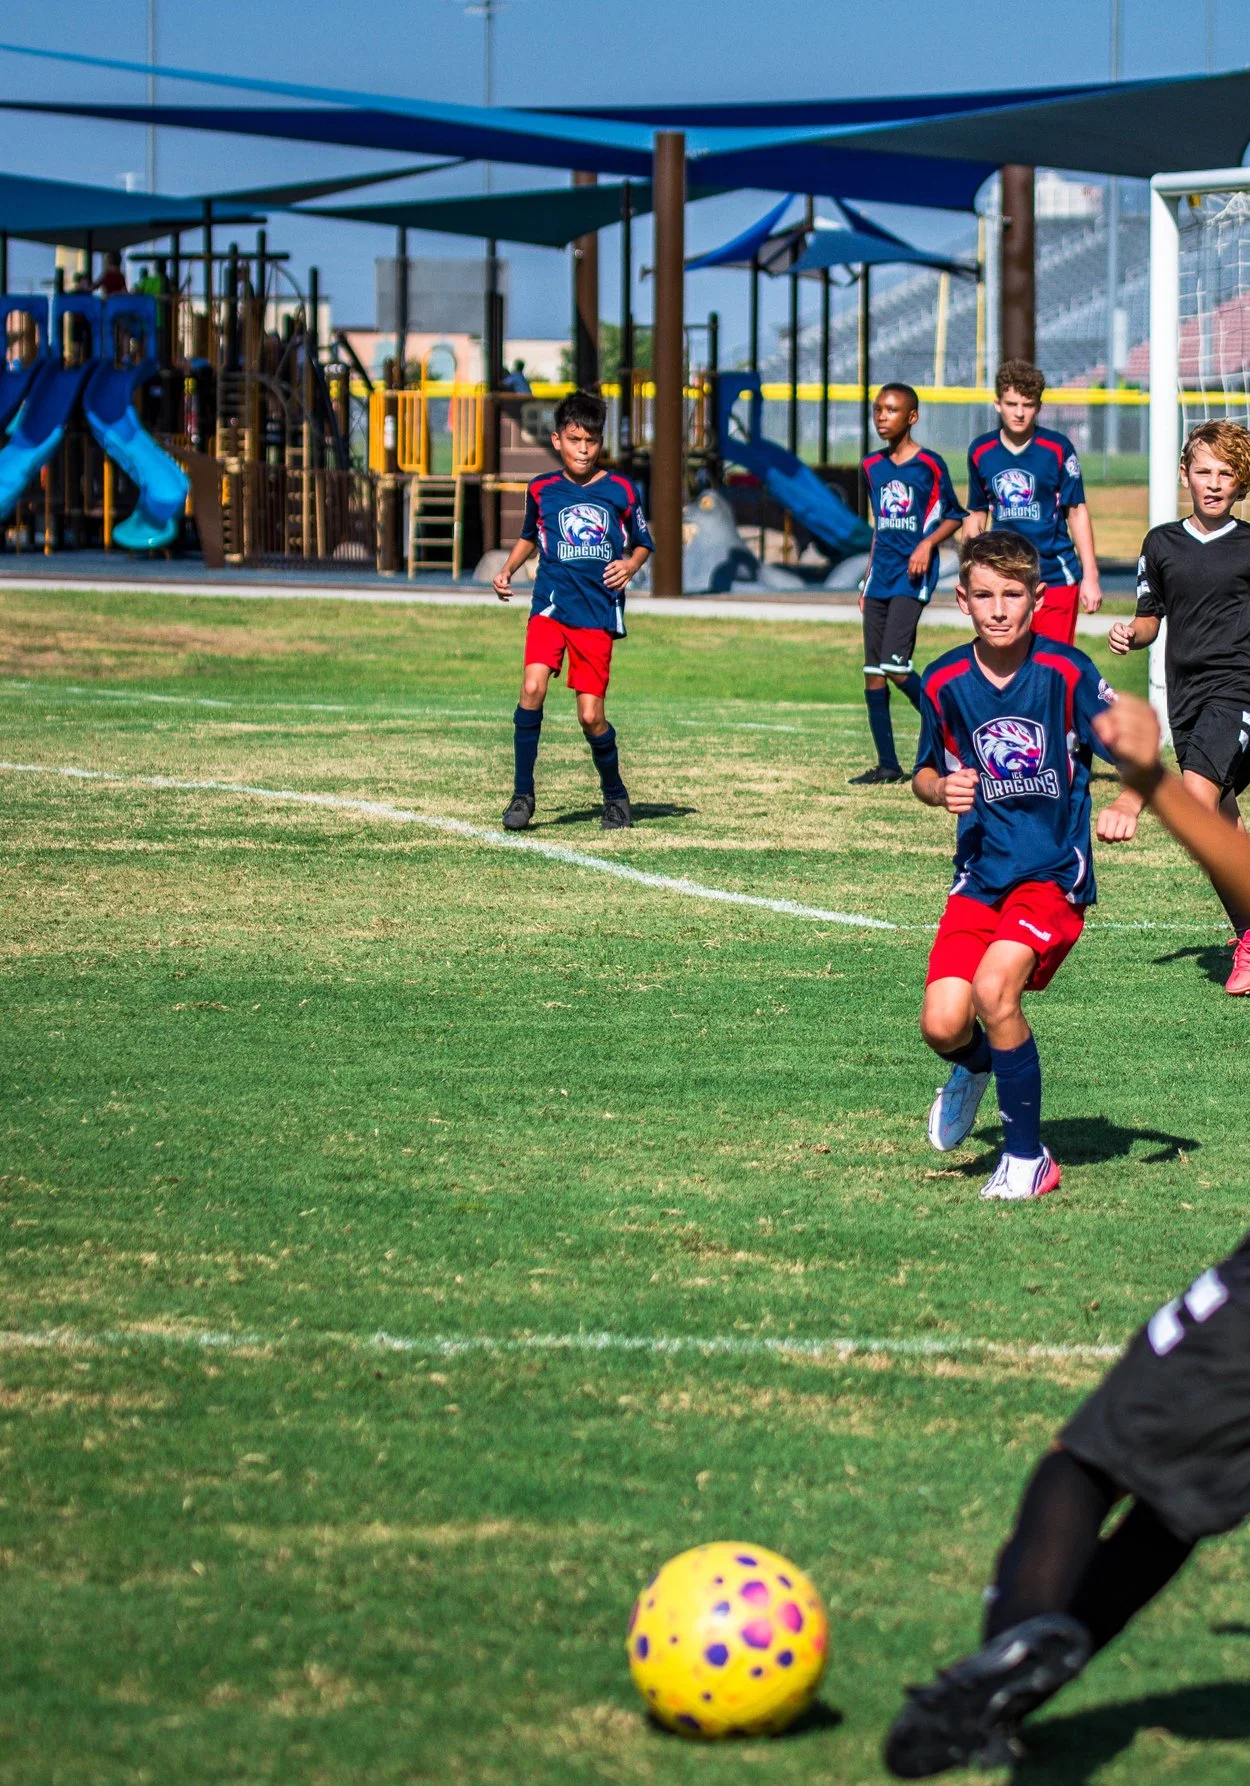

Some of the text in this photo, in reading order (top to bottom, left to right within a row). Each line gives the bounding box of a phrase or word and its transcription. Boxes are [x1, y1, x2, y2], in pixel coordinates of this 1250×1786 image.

[560, 542, 611, 560] DRAGONS
[1011, 771, 1024, 779] ICE
[983, 772, 1058, 799] DRAGONS
